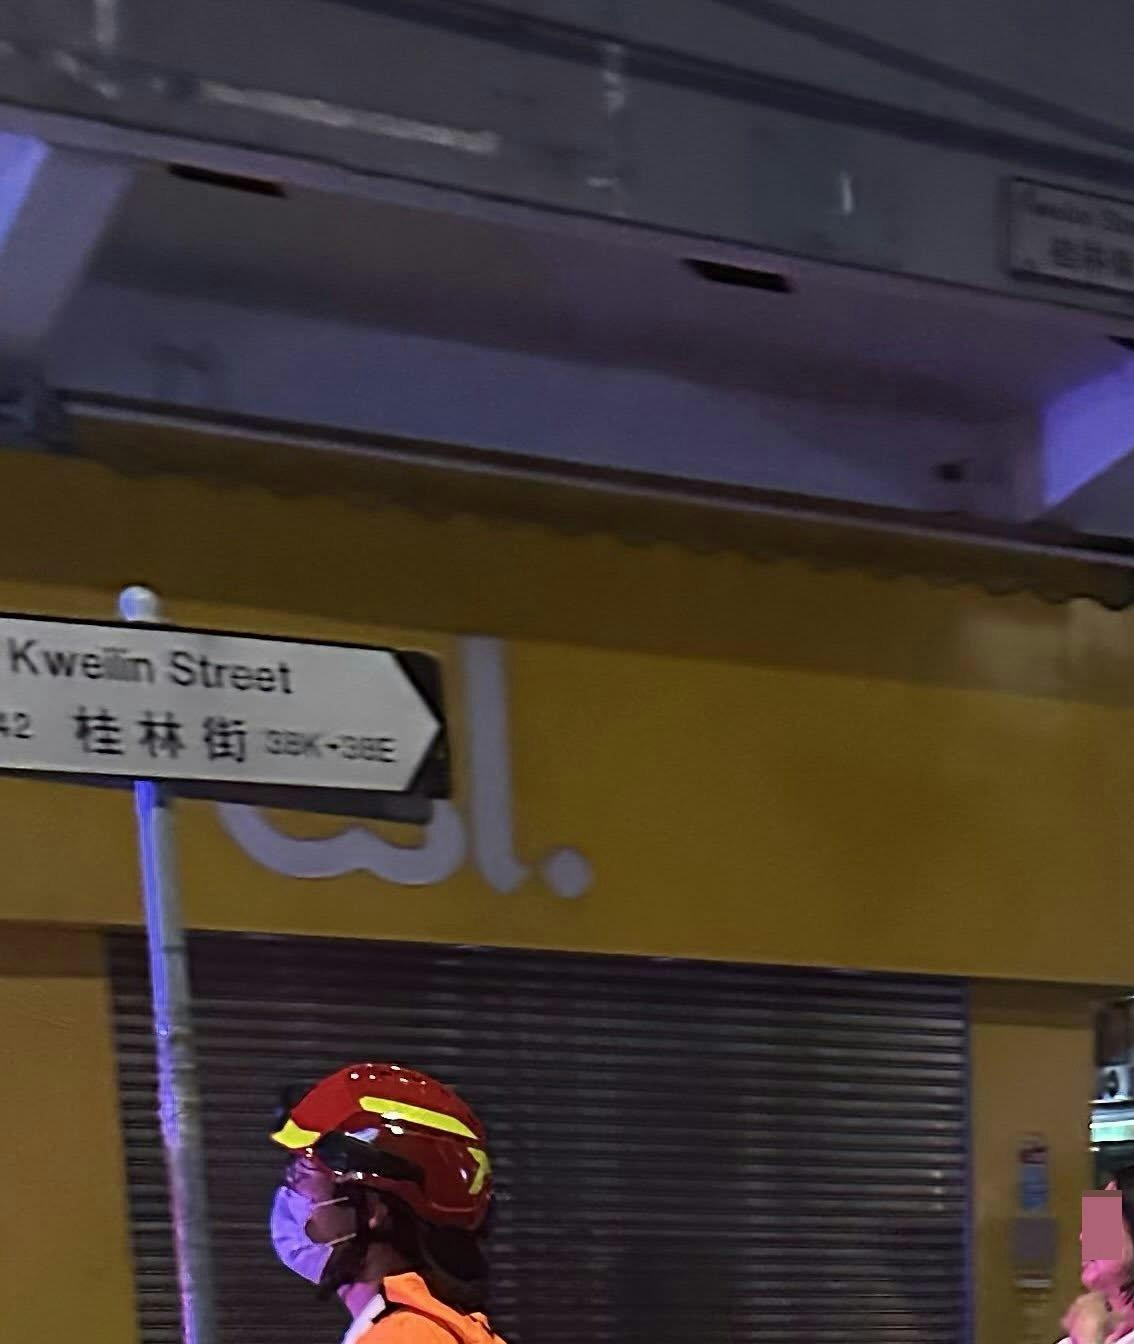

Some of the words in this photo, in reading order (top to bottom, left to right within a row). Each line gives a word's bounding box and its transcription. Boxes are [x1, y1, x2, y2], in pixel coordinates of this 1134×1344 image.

[169, 650, 293, 694] Street
[73, 704, 247, 763] 桂林街
